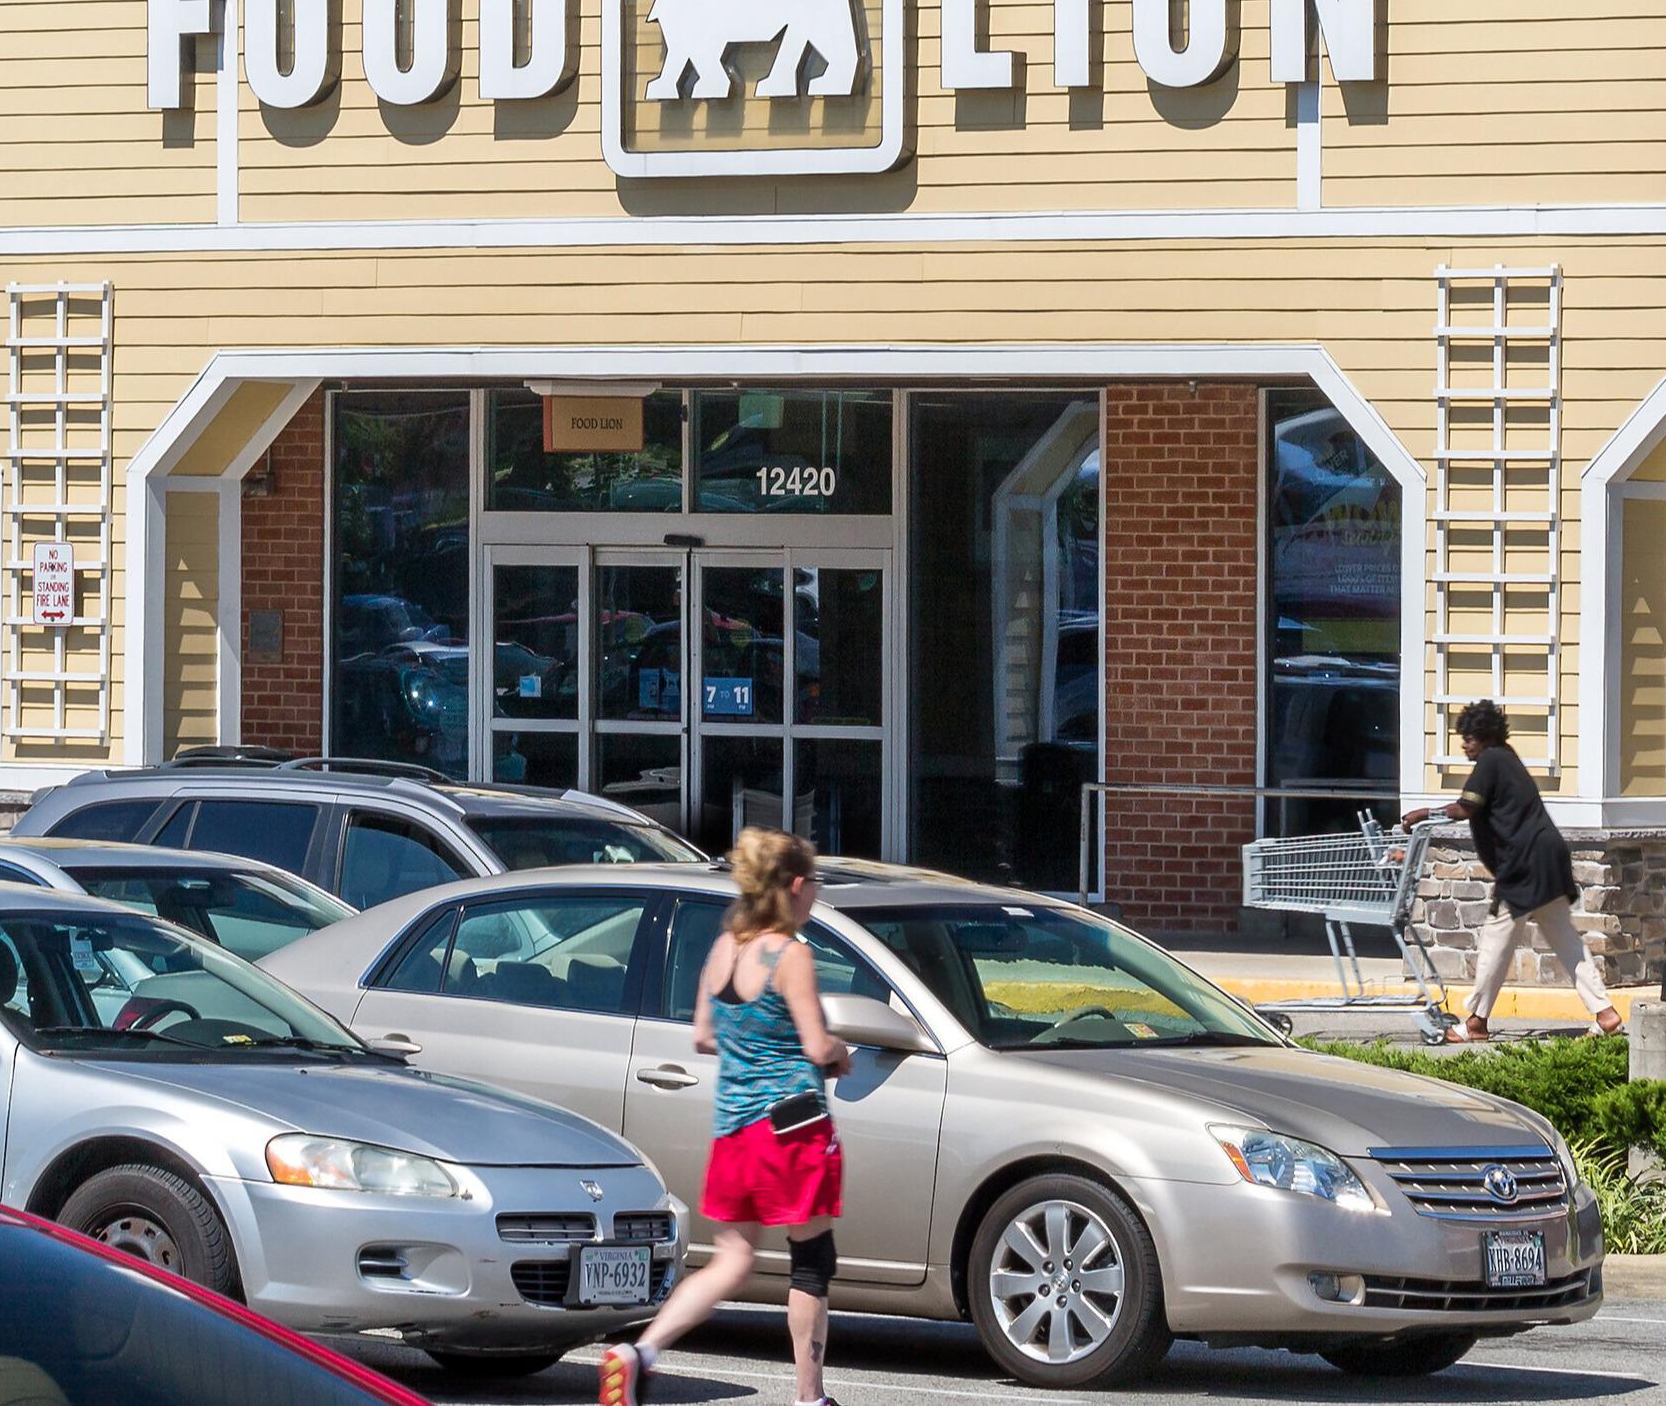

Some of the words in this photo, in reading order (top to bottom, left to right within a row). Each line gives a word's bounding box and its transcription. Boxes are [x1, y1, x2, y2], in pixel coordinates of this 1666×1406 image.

[571, 417, 599, 430] FOOD
[600, 418, 623, 430] LION
[755, 466, 836, 497] 12420
[49, 550, 59, 560] NO
[39, 562, 68, 573] PARKING
[38, 582, 70, 593] STANDING
[37, 594, 50, 607] FIRE
[53, 594, 70, 608] LANE
[706, 685, 717, 703] 7
[719, 690, 731, 699] TO
[733, 685, 749, 704] 11
[599, 1250, 633, 1261] VIRGINIA
